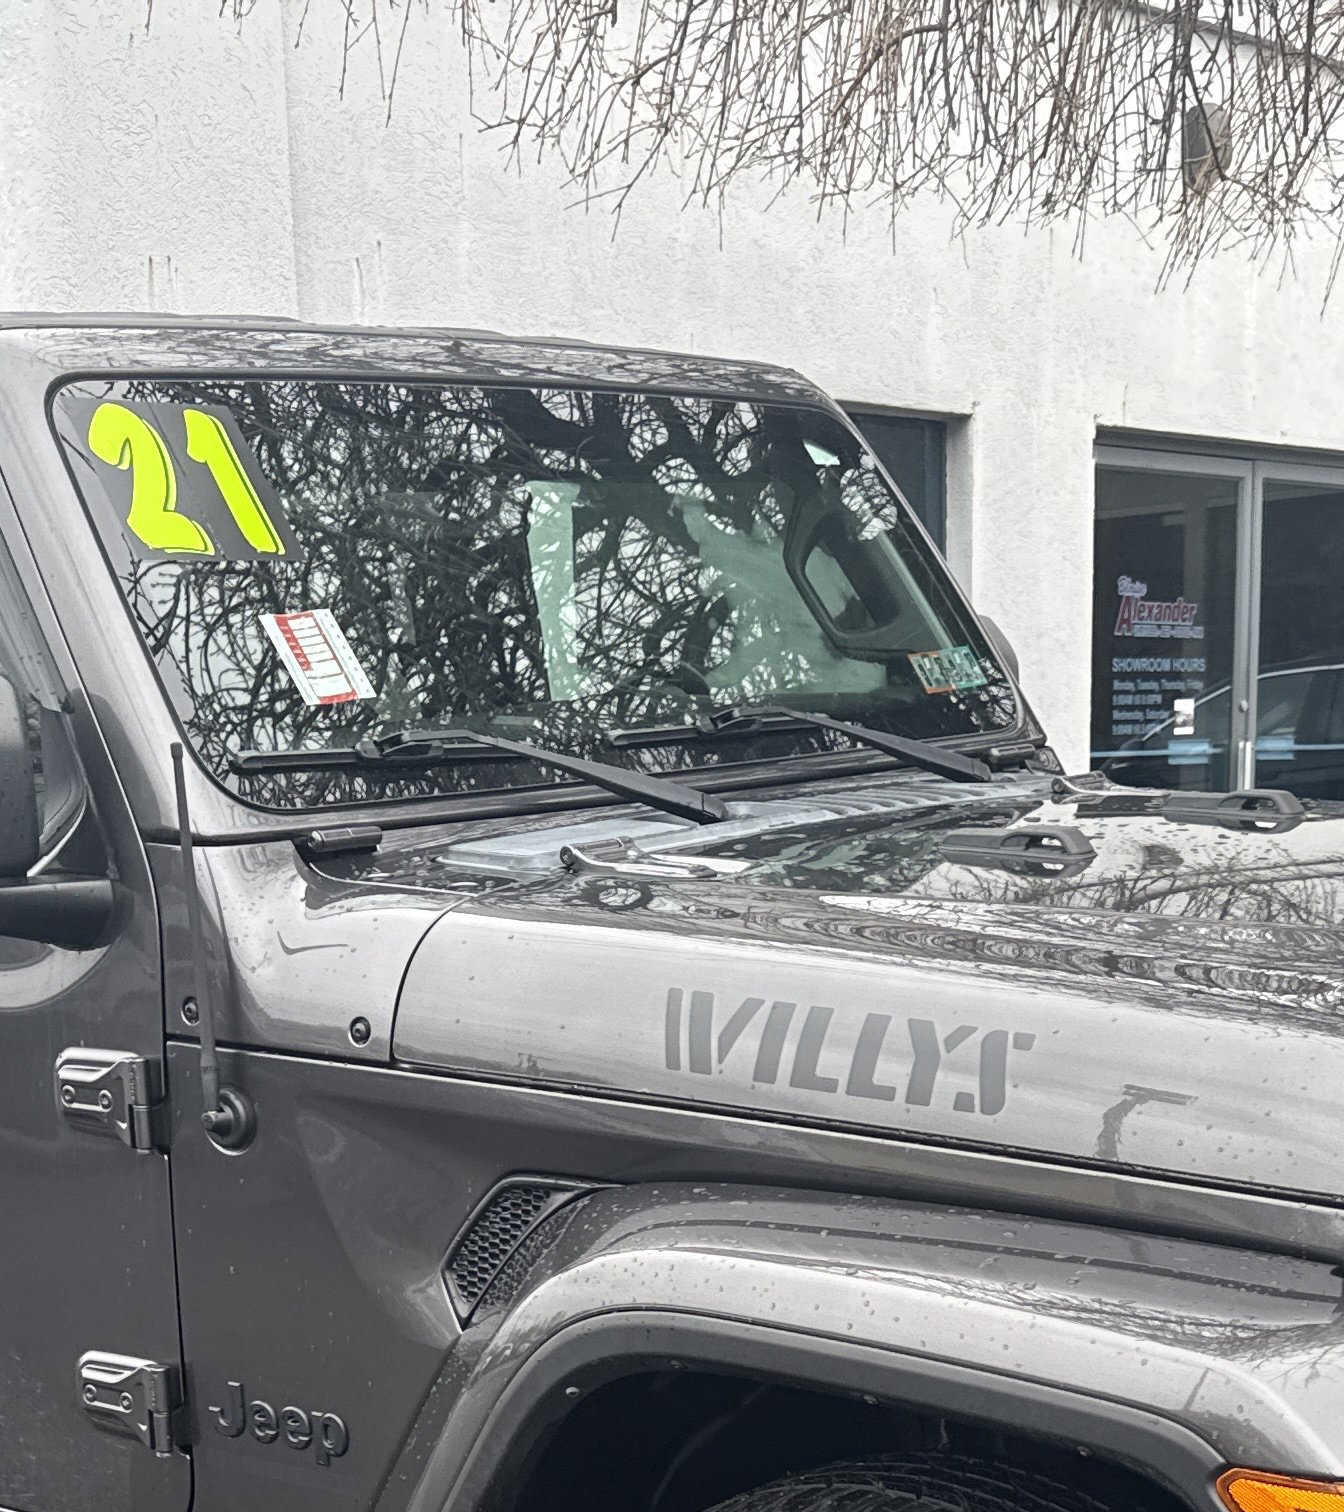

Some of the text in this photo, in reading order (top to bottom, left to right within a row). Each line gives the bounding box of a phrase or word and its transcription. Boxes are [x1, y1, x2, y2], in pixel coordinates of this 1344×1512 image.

[88, 402, 286, 555] 21
[1114, 595, 1197, 636] Alexander
[1112, 657, 1206, 673] SHOWROOM HOURS
[665, 987, 1036, 1116] WILLYS
[208, 1380, 350, 1467] Jeep
